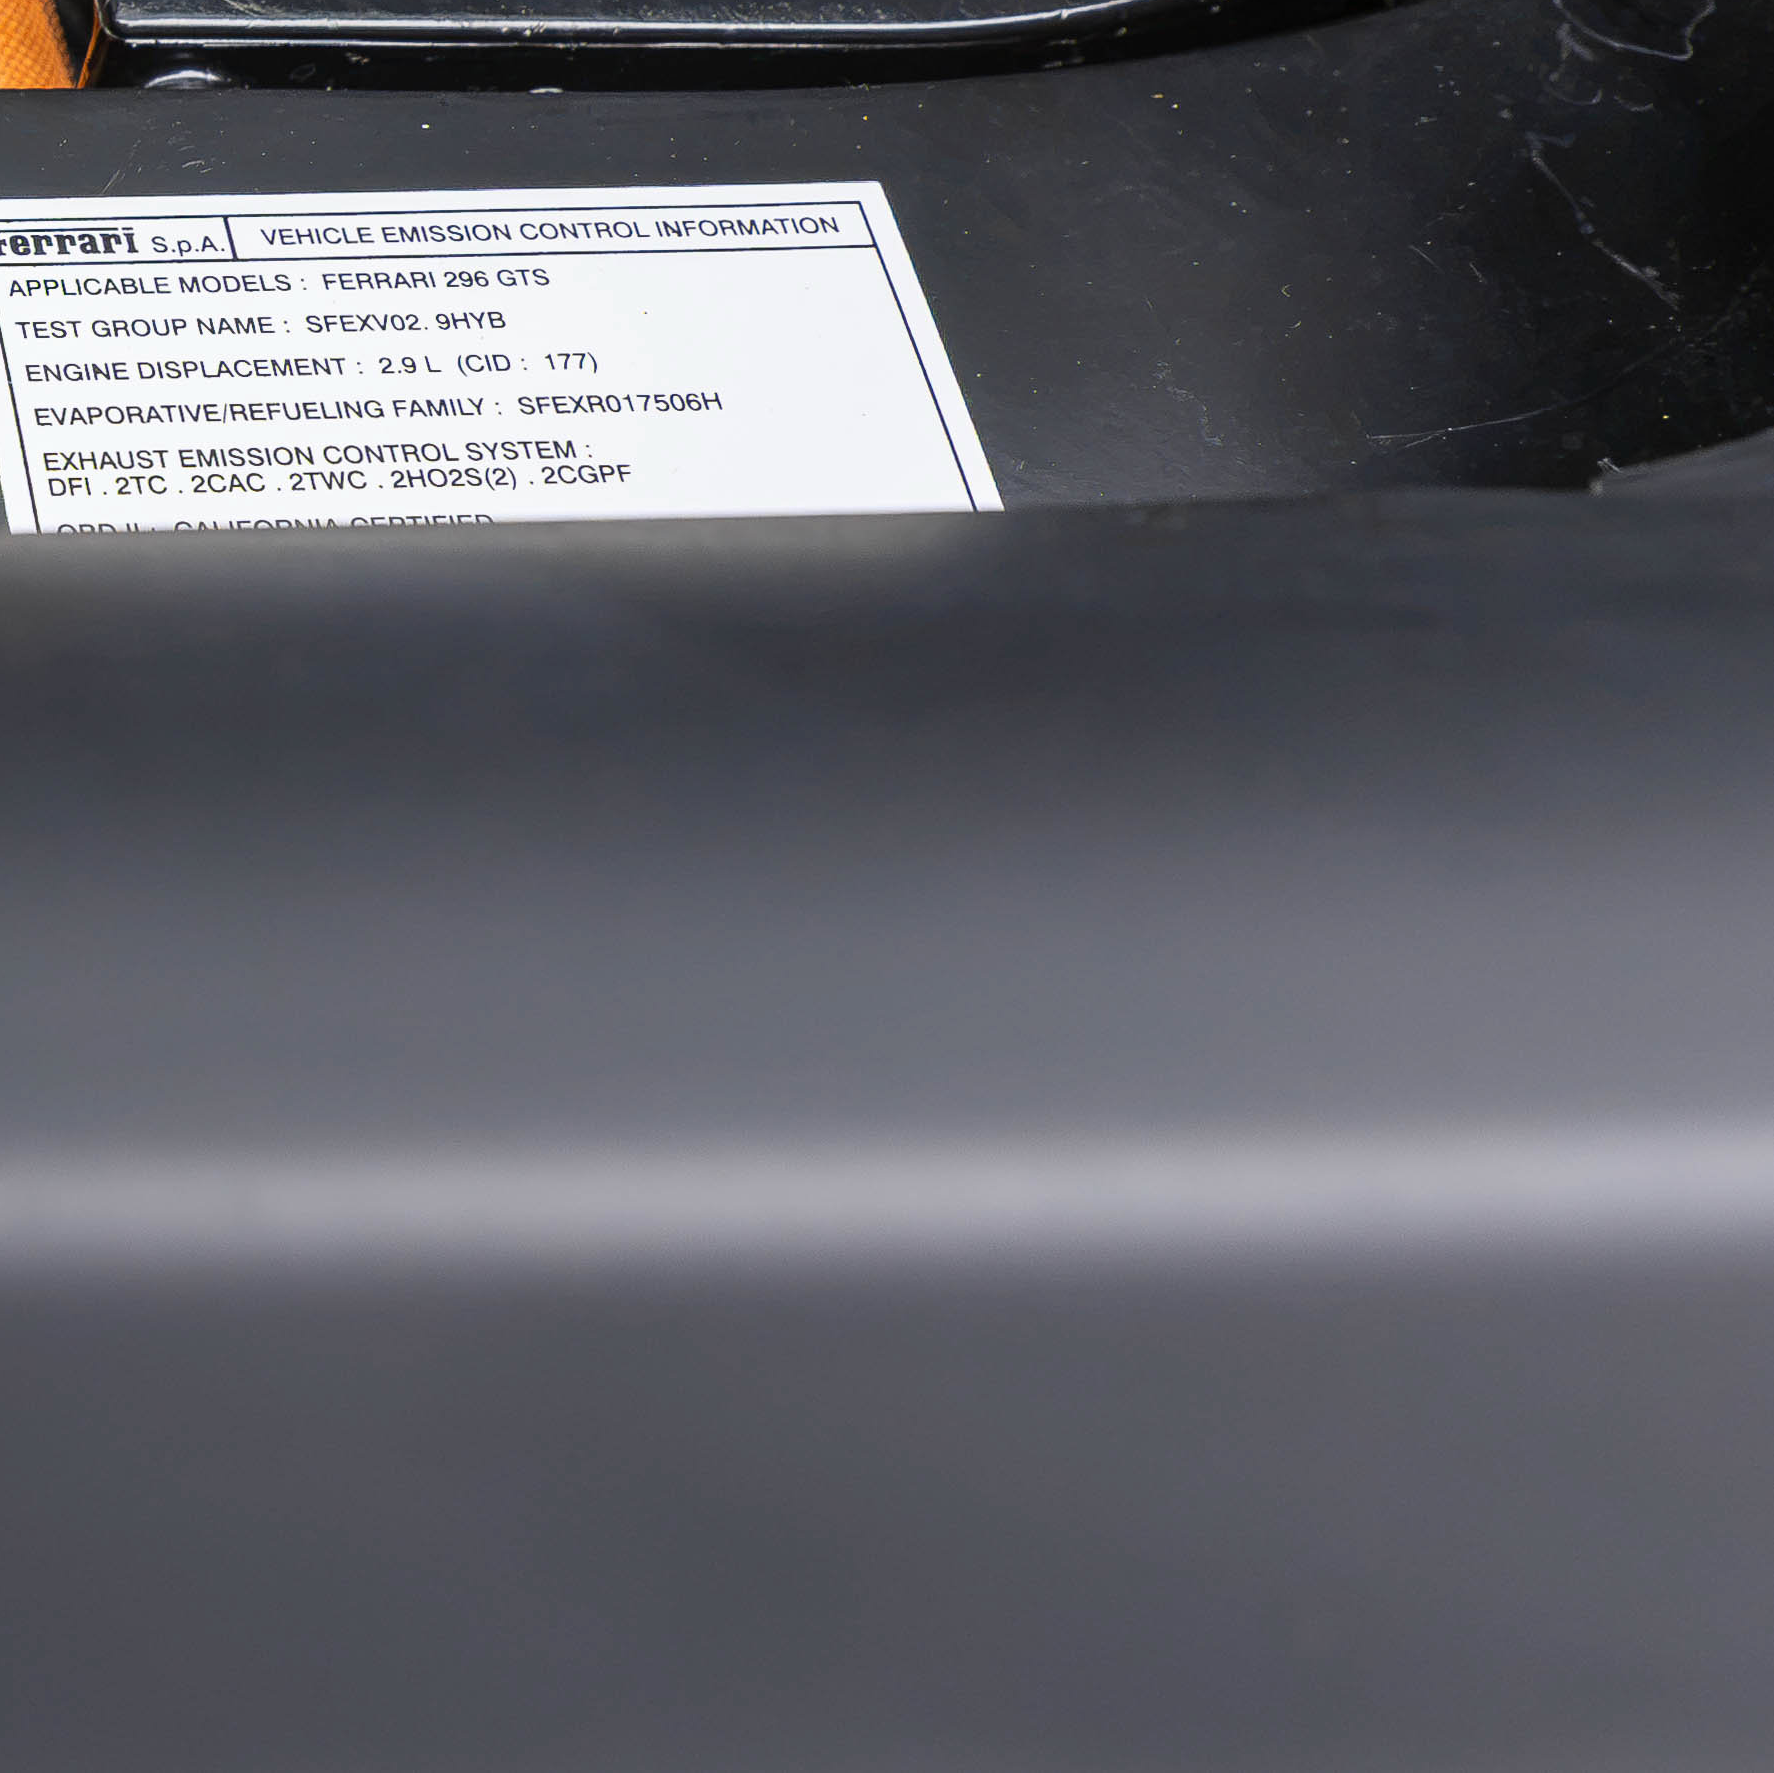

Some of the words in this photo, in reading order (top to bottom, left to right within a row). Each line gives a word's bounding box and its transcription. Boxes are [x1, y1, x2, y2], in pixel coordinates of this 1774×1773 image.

[151, 235, 225, 257] S.p.A.
[260, 226, 375, 246] VEHICLE
[380, 223, 513, 243] EMISSION
[519, 221, 651, 241] CONTROL
[654, 216, 840, 238] INFORMATION
[9, 276, 172, 297] APPLICABLE
[178, 273, 292, 294] MODELS
[321, 271, 437, 291] FERRARI
[443, 270, 490, 288] 296
[496, 268, 550, 287] GTS
[14, 320, 82, 339] TEST
[91, 318, 187, 338] GROUP
[196, 316, 276, 336] NAME
[435, 311, 507, 331] 9HYB
[25, 362, 130, 383] ENGINE
[136, 357, 346, 380] DISPLACEMENT
[378, 356, 417, 374] 2.9
[424, 355, 442, 373] L
[457, 354, 511, 377] (CID
[544, 351, 598, 374] 177)
[33, 399, 385, 427] EVAPORATIVE/REFUELING
[391, 397, 484, 418] FAMILY
[517, 391, 723, 416] SFEXR017506H
[42, 449, 169, 472] EXHAUST
[177, 446, 315, 468] EMISSION
[322, 442, 460, 465] CONTROL
[465, 439, 577, 462] SYSTEM
[47, 476, 92, 497] DFI
[115, 474, 168, 496] 2TC
[191, 472, 266, 494] 2CAC
[289, 469, 368, 492] 2TWC
[390, 466, 517, 491] 2HO2S(2)
[541, 464, 631, 485] 2CGPF
